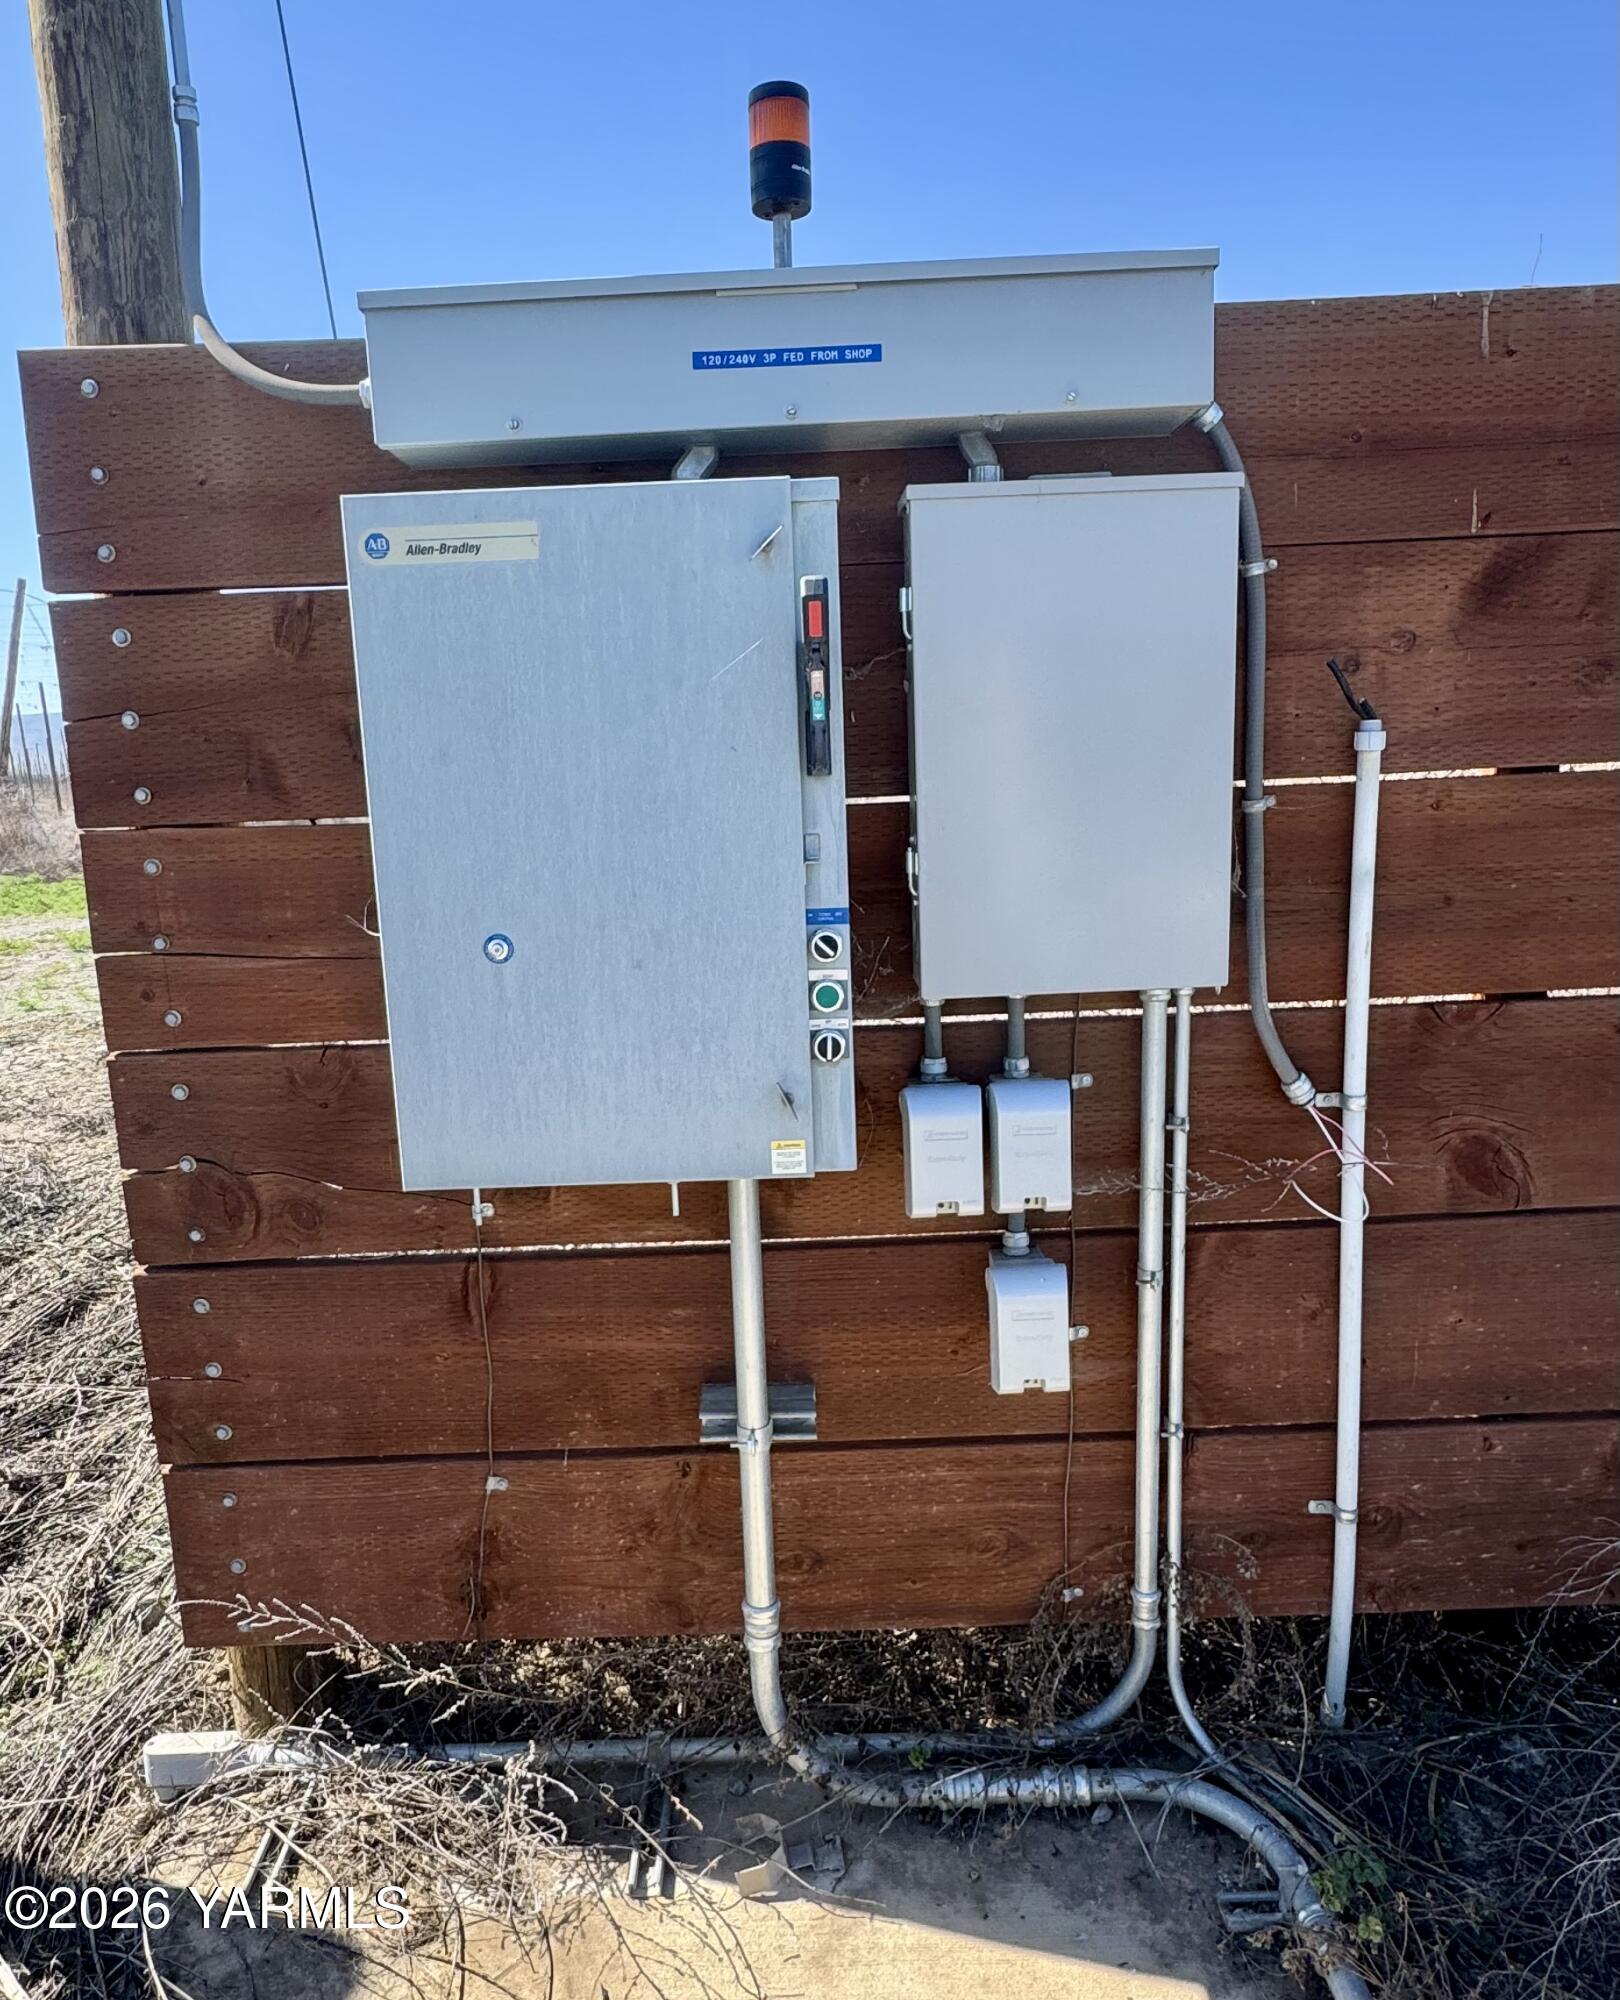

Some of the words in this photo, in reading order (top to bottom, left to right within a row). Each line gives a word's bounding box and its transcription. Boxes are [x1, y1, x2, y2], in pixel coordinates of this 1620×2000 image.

[702, 354, 757, 366] 120/240V
[763, 352, 777, 364] 3P
[783, 352, 804, 363] FED
[810, 350, 839, 362] FROM
[844, 348, 873, 360] SHOP
[367, 538, 387, 550] AB
[405, 542, 482, 557] Allen-Bradley
